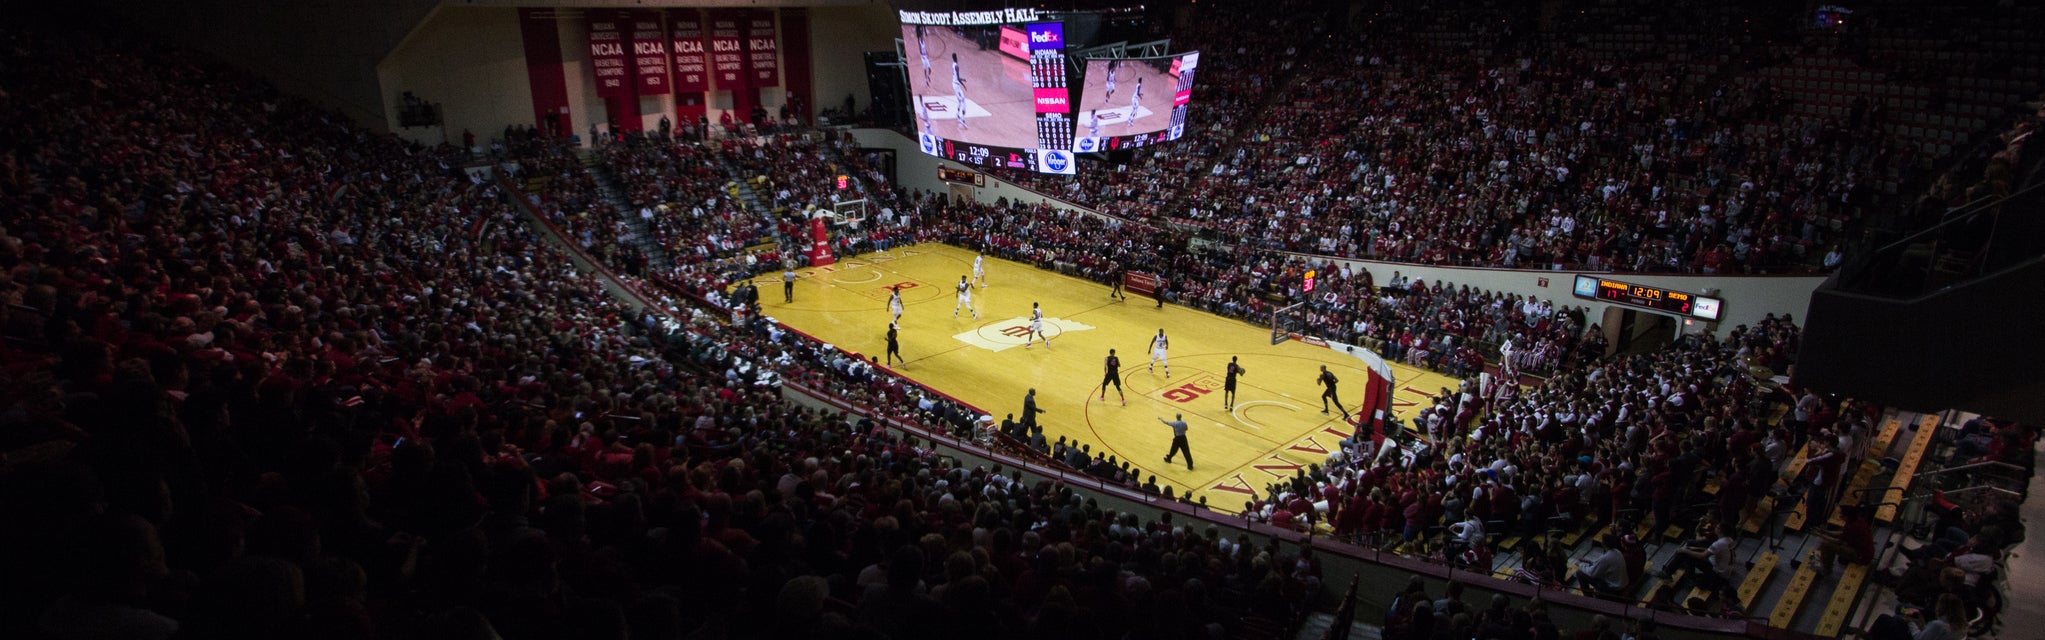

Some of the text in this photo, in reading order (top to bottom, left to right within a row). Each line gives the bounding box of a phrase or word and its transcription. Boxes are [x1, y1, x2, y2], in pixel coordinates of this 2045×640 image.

[900, 8, 1038, 25] SIMON SKJODT ASSEMBLY HALL
[1031, 31, 1058, 43] FedEx
[591, 43, 624, 56] NCAA
[634, 41, 665, 55] NCAA
[674, 40, 704, 53] NCAA
[713, 39, 741, 52] NCAA
[749, 38, 776, 51] NCAA
[958, 153, 966, 161] 17
[969, 146, 989, 158] 12:09
[995, 158, 1001, 166] 2
[1600, 280, 1628, 290] INDIANA
[1607, 290, 1617, 298] 17
[1634, 287, 1660, 298] 12:09
[1668, 292, 1688, 301] SEMO
[1681, 303, 1689, 312] 2
